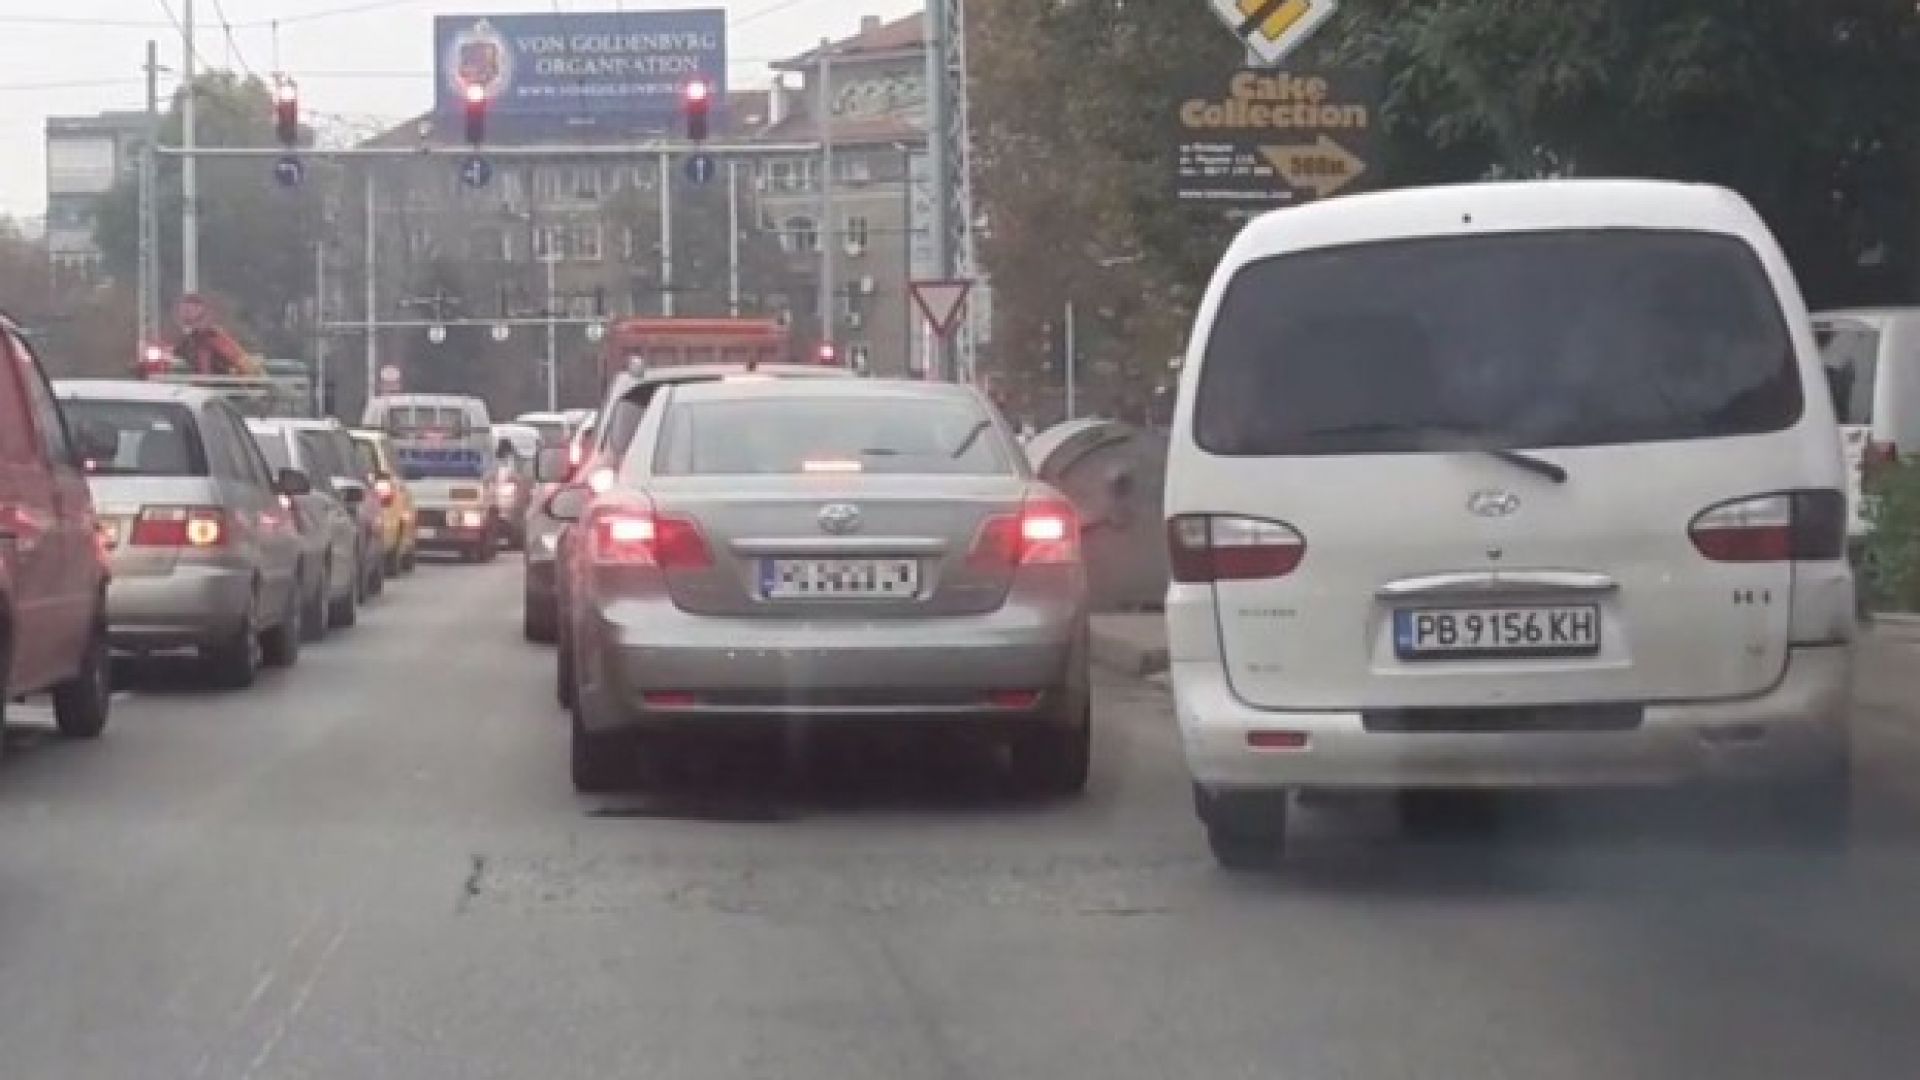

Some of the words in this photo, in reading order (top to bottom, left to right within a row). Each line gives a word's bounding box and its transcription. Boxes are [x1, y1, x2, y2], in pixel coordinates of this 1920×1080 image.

[518, 36, 564, 53] VON
[1232, 71, 1328, 100] Cake
[1180, 99, 1368, 128] Collection
[1417, 614, 1457, 645] PB
[1464, 611, 1542, 645] 9156
[1549, 609, 1593, 642] KH
